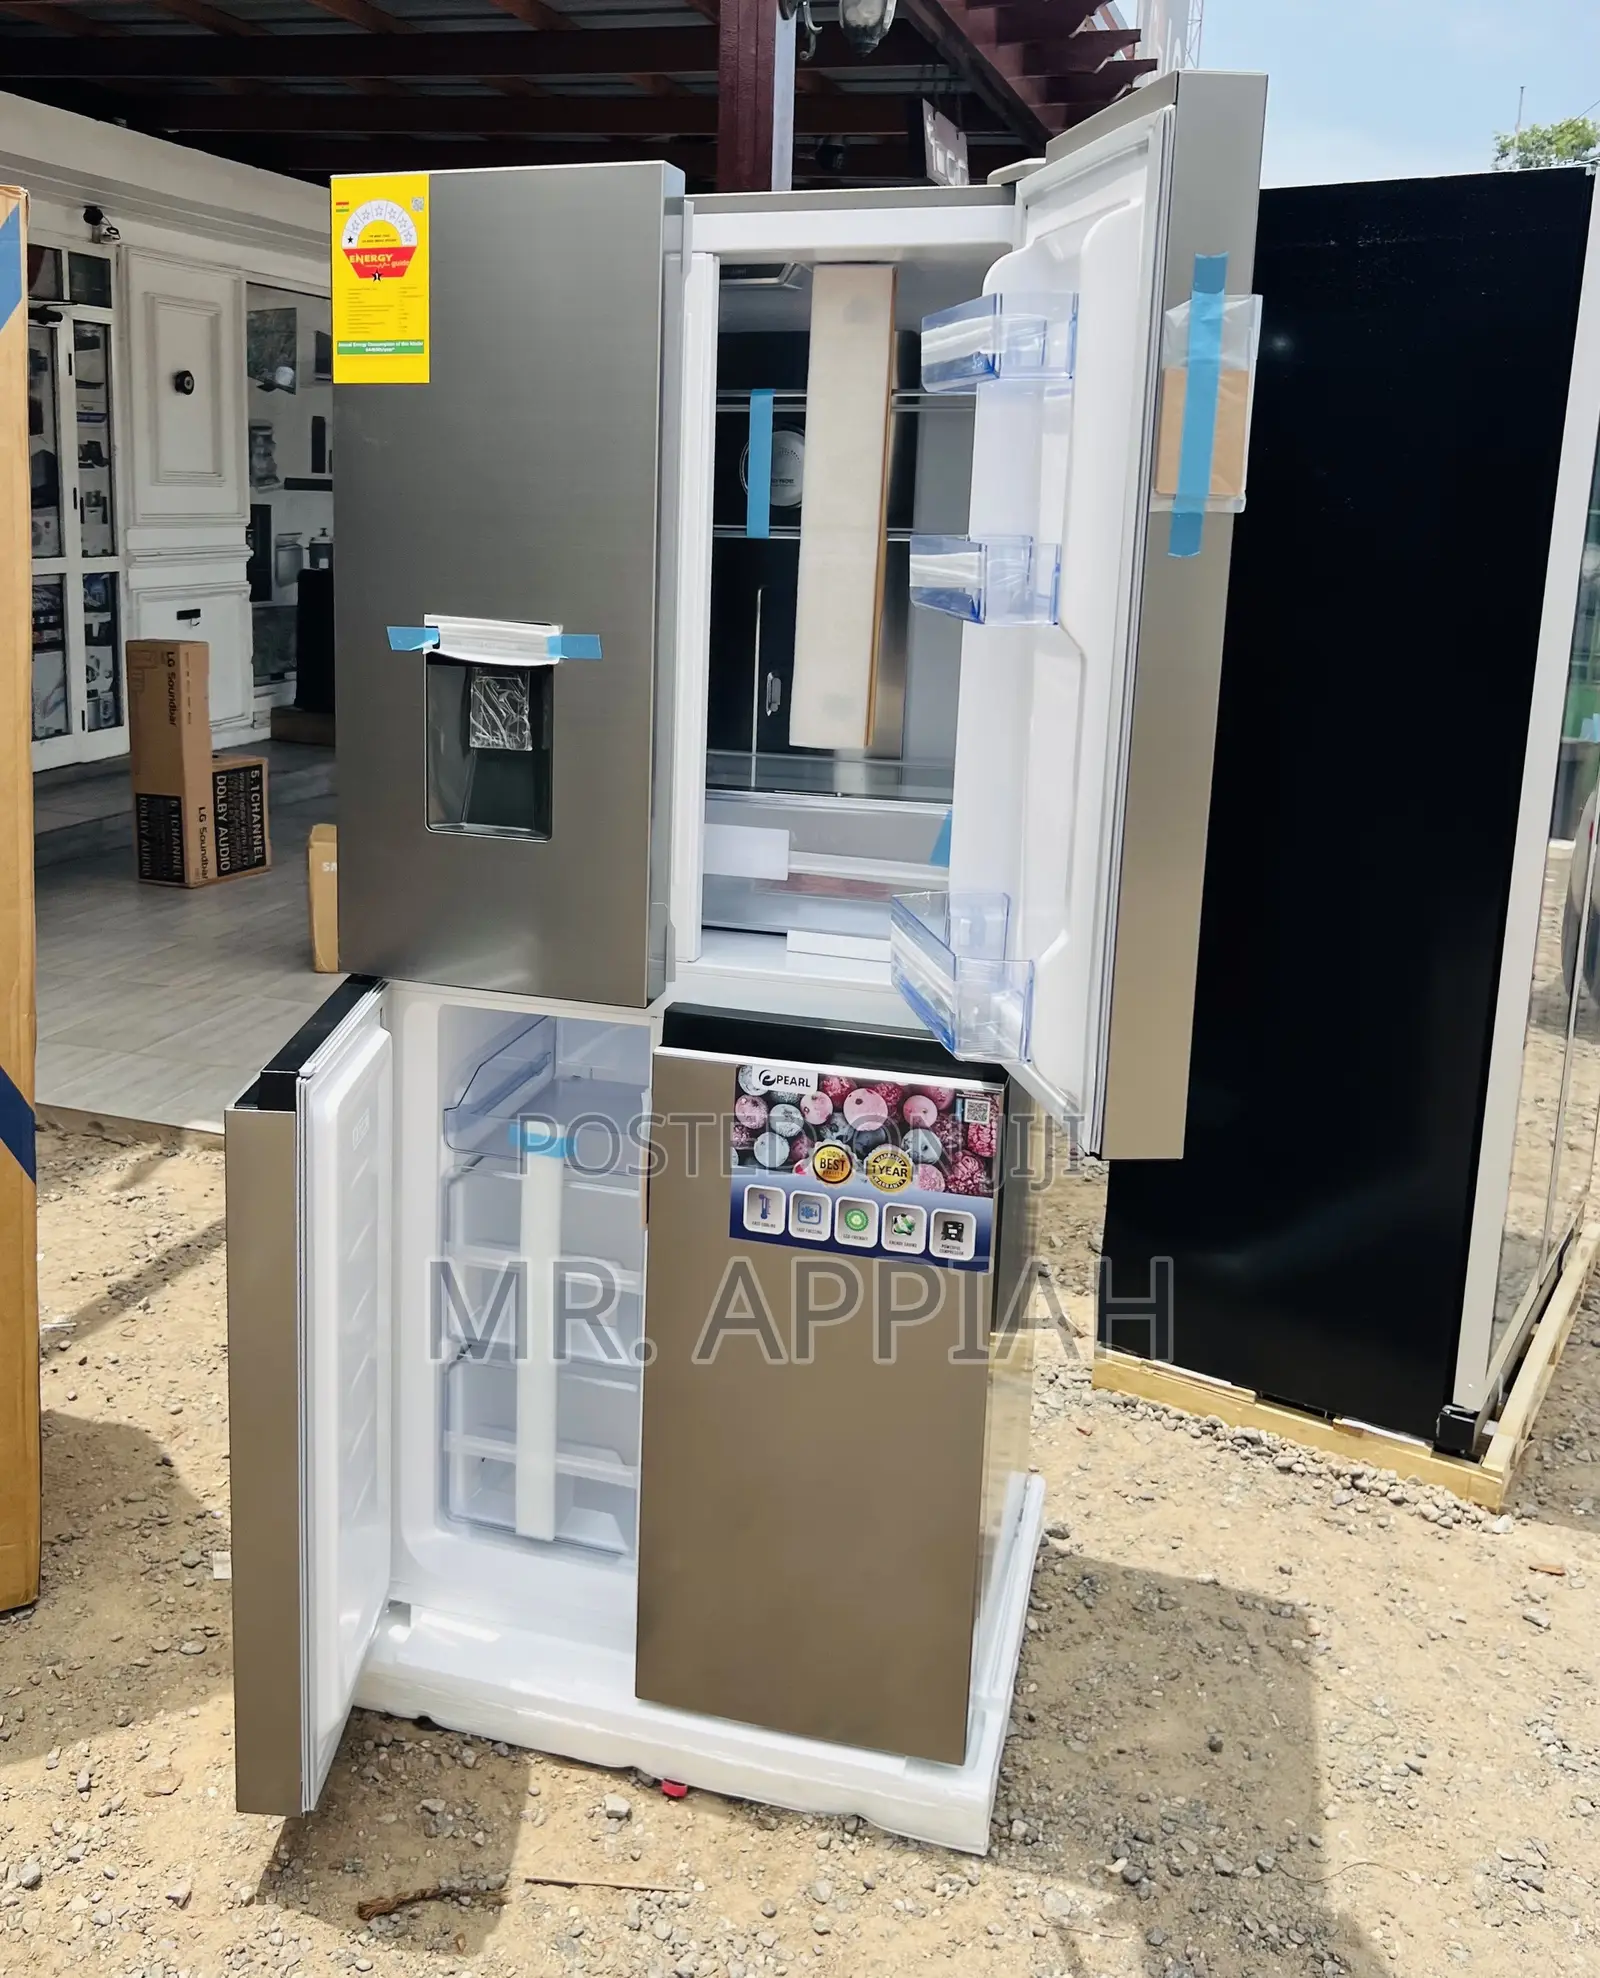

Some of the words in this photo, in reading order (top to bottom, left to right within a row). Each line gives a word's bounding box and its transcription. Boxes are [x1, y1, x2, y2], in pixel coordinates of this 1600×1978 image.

[349, 253, 393, 264] ENERGY
[167, 651, 175, 667] LG
[167, 672, 177, 726] Soundbar
[216, 775, 228, 821] DOLBY
[198, 806, 206, 822] LG
[200, 827, 208, 879] Soundbar
[218, 827, 231, 871] AUDIO
[776, 1074, 811, 1088] PEARL
[820, 1158, 846, 1172] BEST
[871, 1165, 876, 1174] 1
[878, 1164, 908, 1178] YEAR
